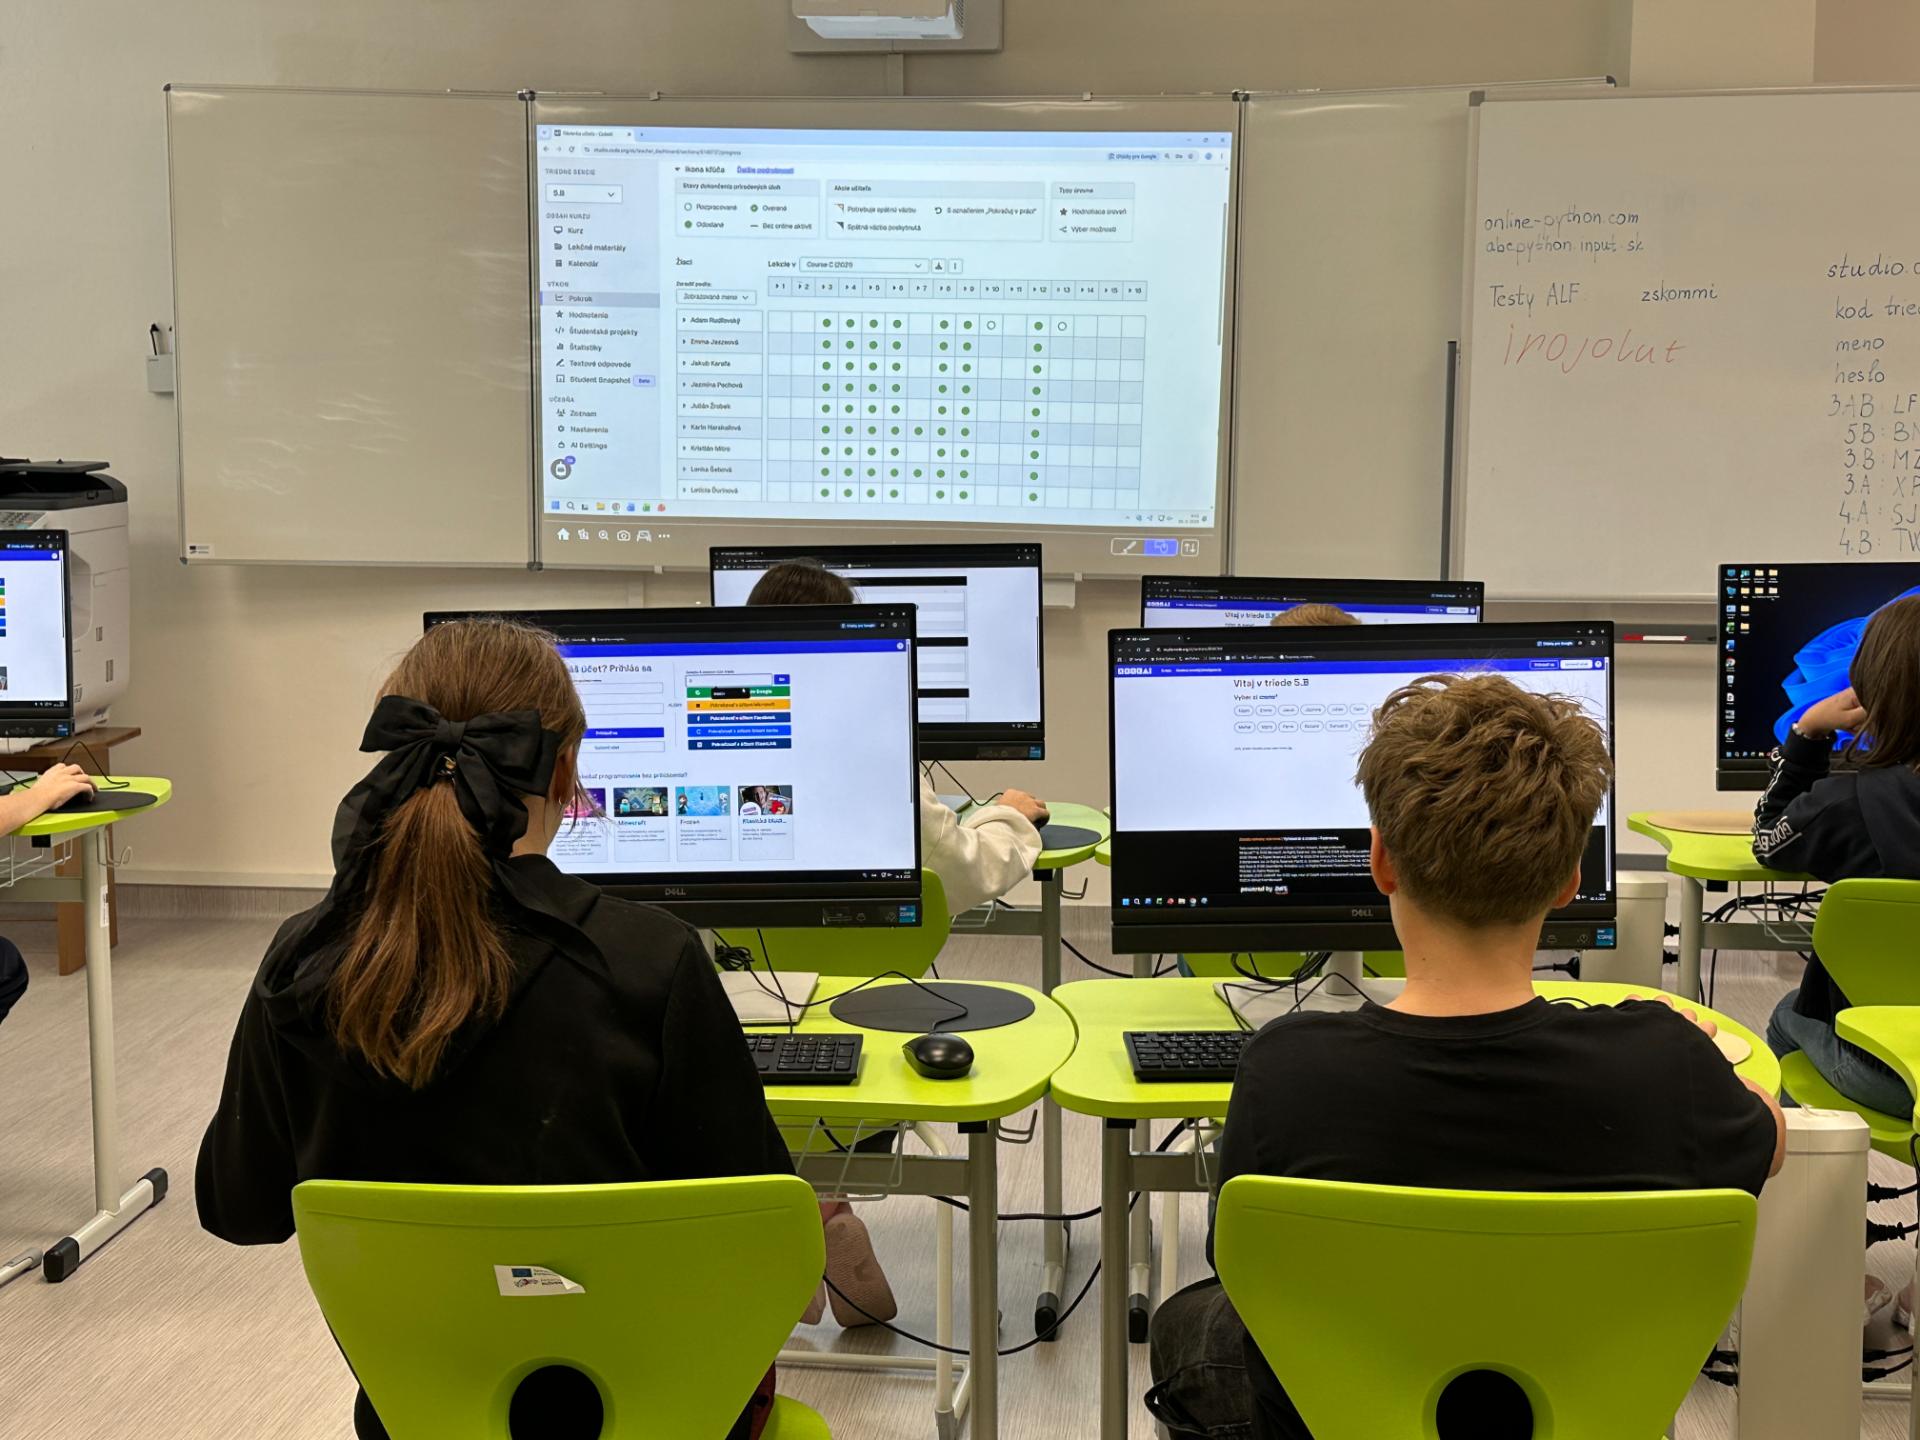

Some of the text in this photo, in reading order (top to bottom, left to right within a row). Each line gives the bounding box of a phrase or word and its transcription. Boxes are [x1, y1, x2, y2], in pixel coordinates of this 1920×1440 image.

[1489, 282, 1580, 319] Testy ALF
[1835, 296, 1873, 319] kod
[1834, 336, 1885, 352] meno
[1834, 358, 1885, 384] heslo
[570, 376, 597, 384] Student
[599, 376, 631, 385] Snapshot
[1233, 679, 1255, 689] Vitaj
[1265, 679, 1293, 687] triede
[665, 888, 687, 896] DELL
[1351, 909, 1374, 917] DELL
